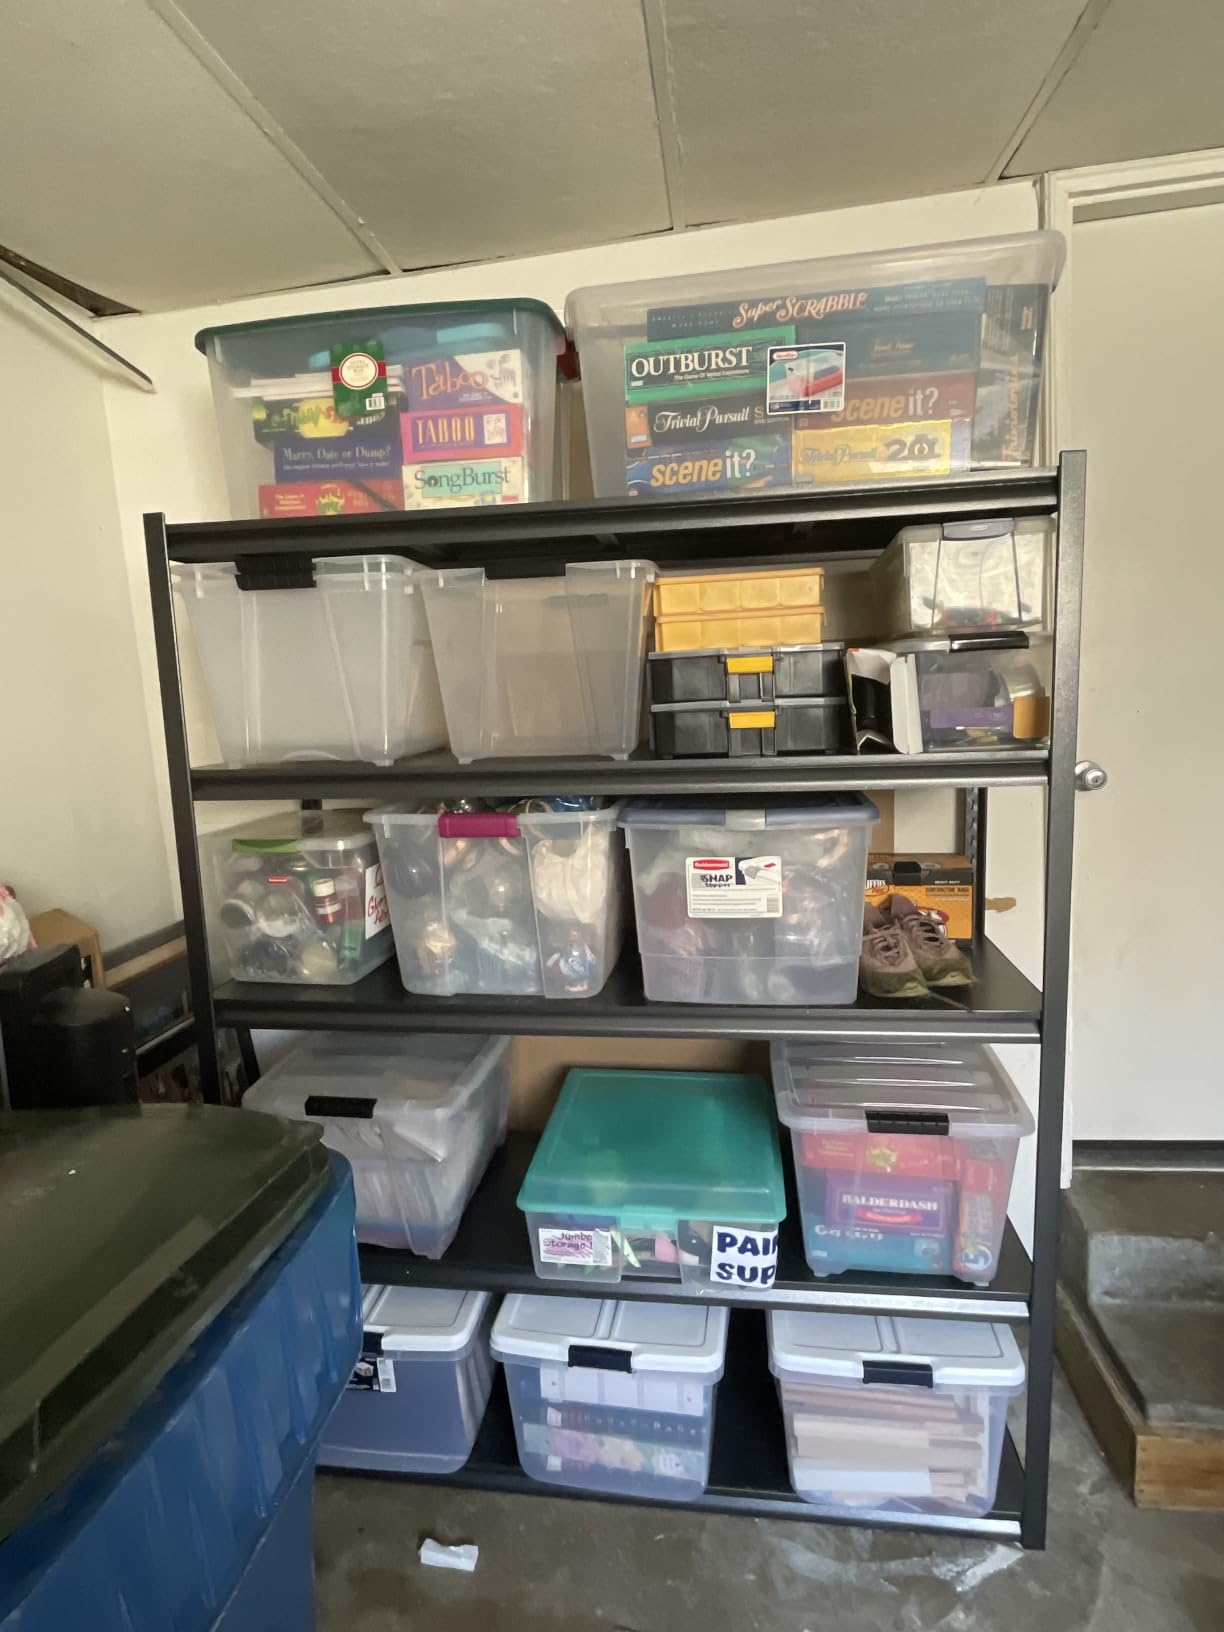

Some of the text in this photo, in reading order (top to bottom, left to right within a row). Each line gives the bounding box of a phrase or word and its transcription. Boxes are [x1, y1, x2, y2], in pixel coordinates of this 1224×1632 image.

[732, 299, 780, 329] Super
[777, 293, 868, 320] SCRABBLE
[631, 346, 753, 378] OUTBURST
[411, 361, 489, 400] Taboo
[907, 387, 939, 416] it?
[416, 415, 476, 445] TABOO
[653, 408, 701, 433] Trivial
[696, 404, 750, 433] Pursuit
[414, 466, 511, 494] SongBurst
[650, 448, 757, 487] scene it?
[702, 874, 733, 883] SNAP
[841, 1194, 939, 1212] BALDERDASH
